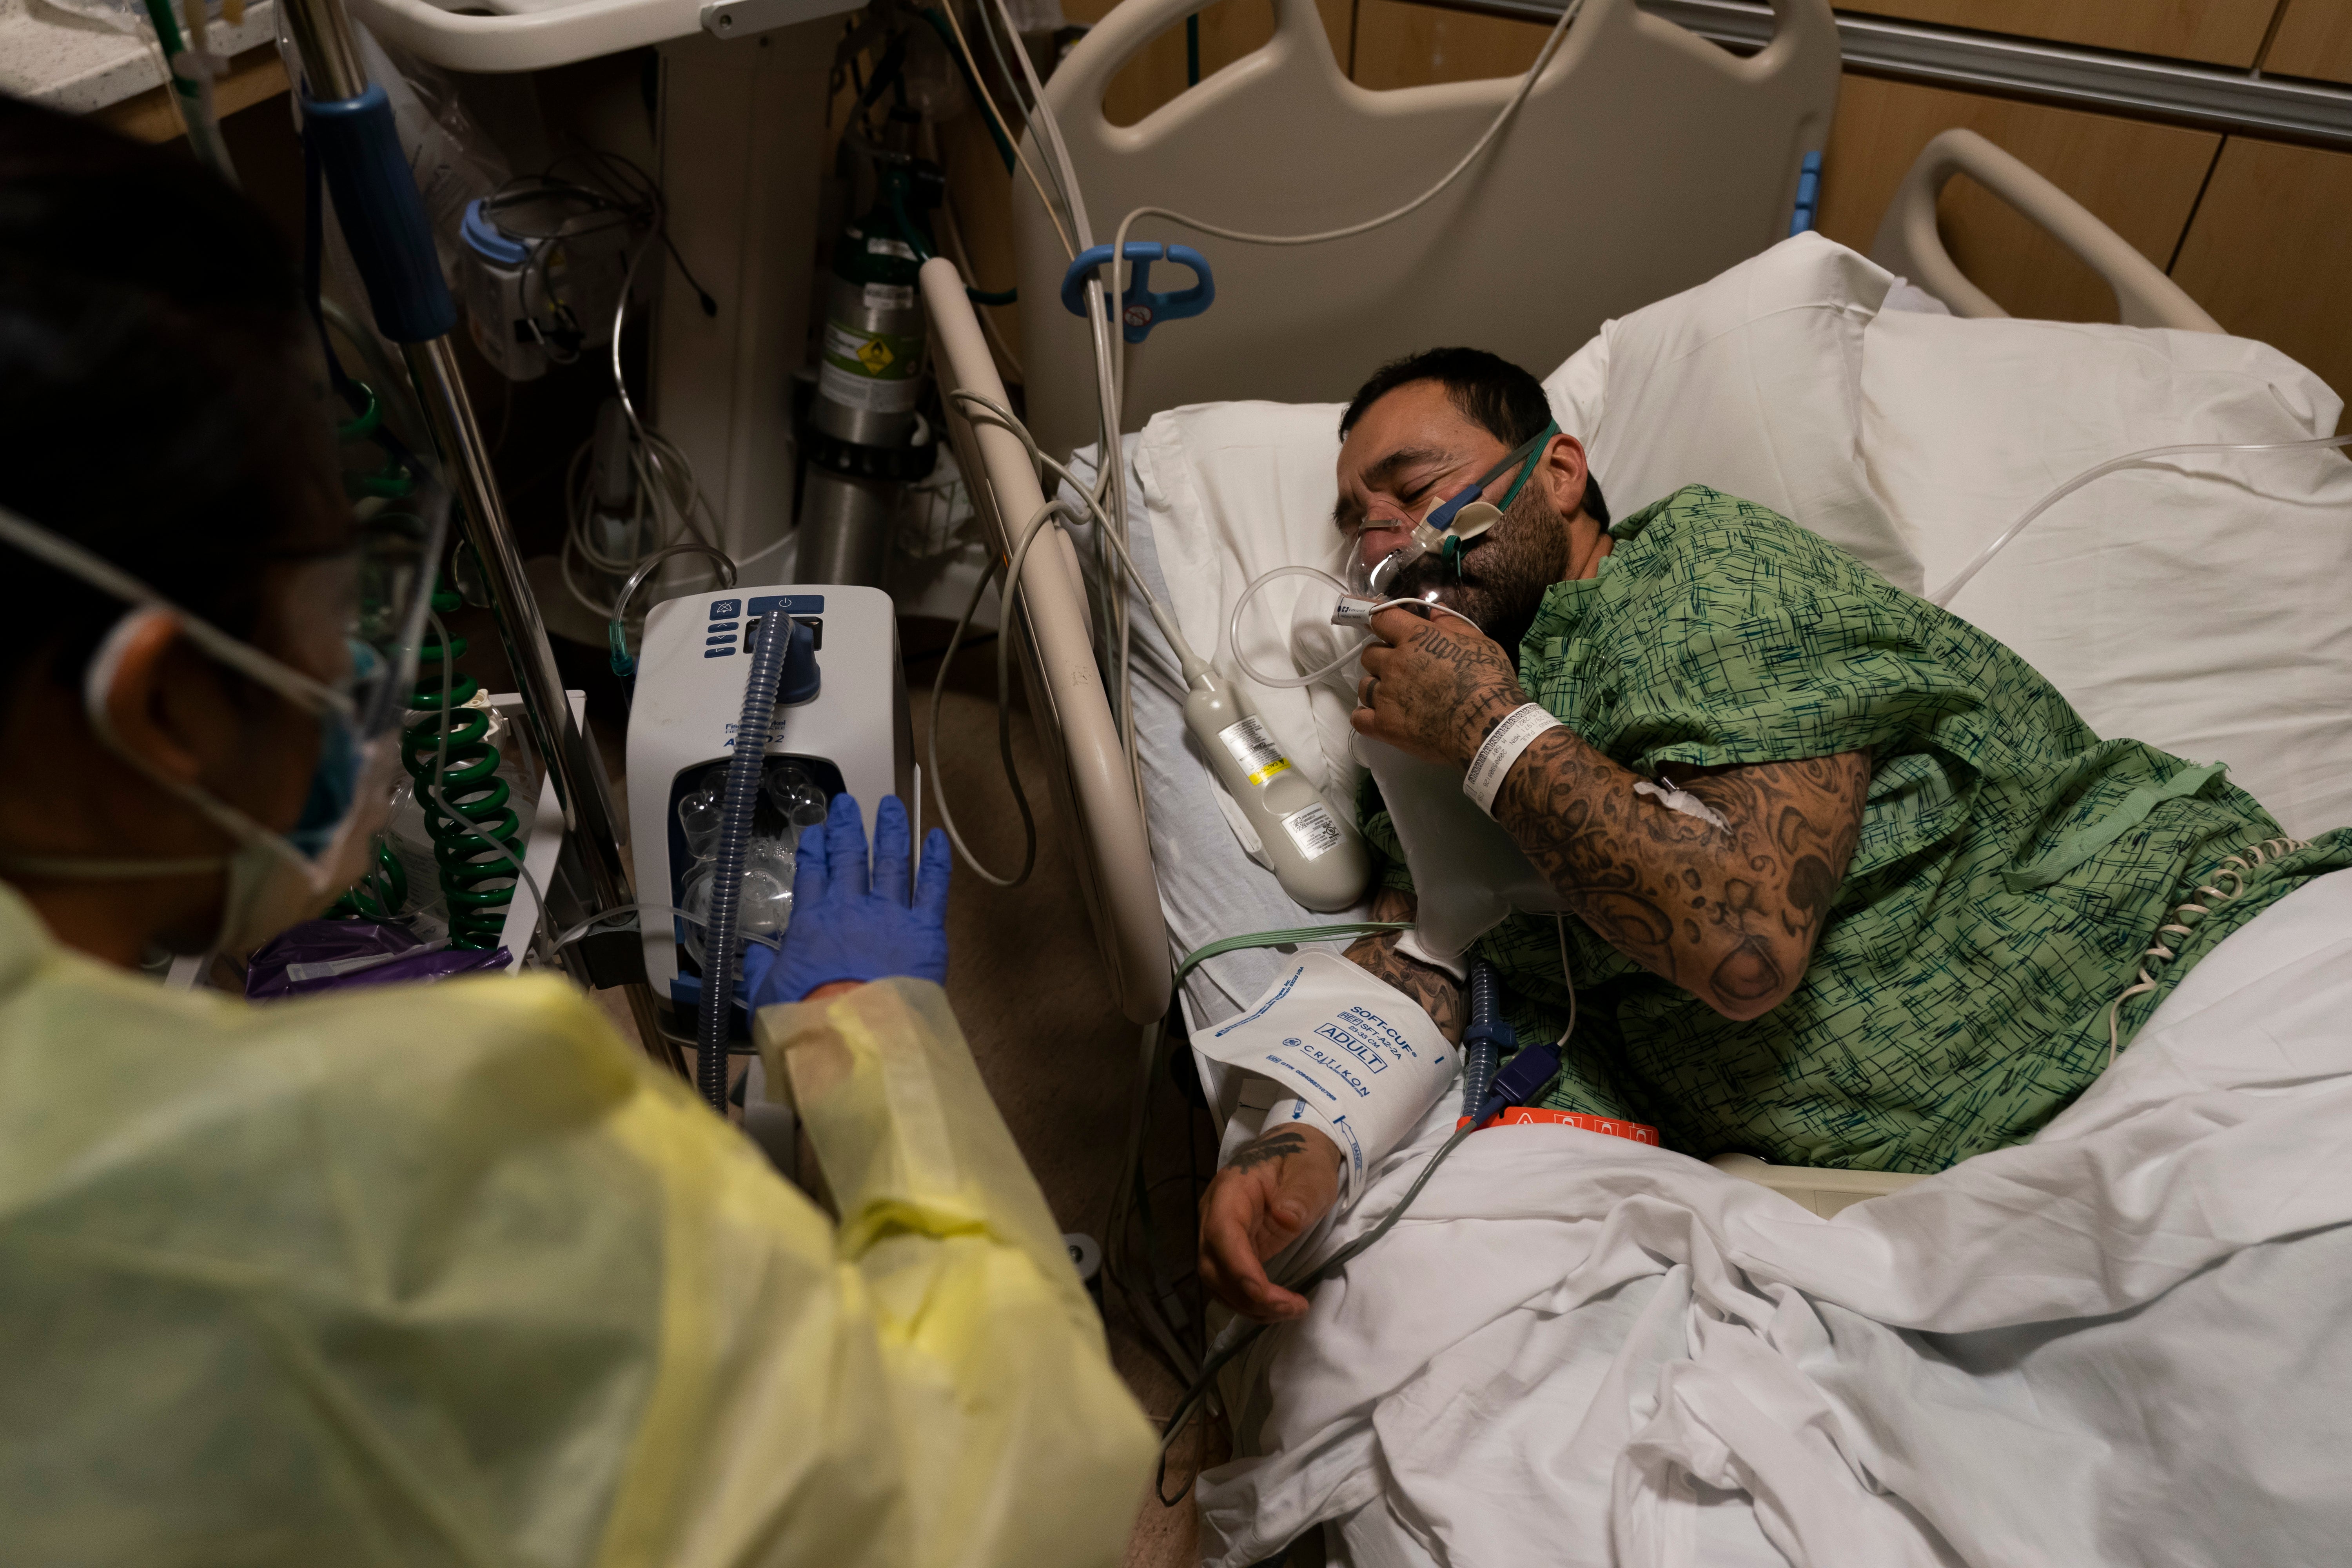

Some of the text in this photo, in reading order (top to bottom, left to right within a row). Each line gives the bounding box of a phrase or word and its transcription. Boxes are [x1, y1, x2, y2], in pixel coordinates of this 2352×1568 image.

[1520, 730, 1536, 742] PAUL
[1492, 745, 1502, 758] 50Y
[1289, 975, 1299, 987] 53223
[1296, 966, 1305, 975] USA
[1320, 1027, 1383, 1065] ADULT
[1340, 1012, 1402, 1060] REF SFT-A2-2A
[1348, 1025, 1381, 1049] 23-33 CM
[1352, 1142, 1361, 1169] RANGE
